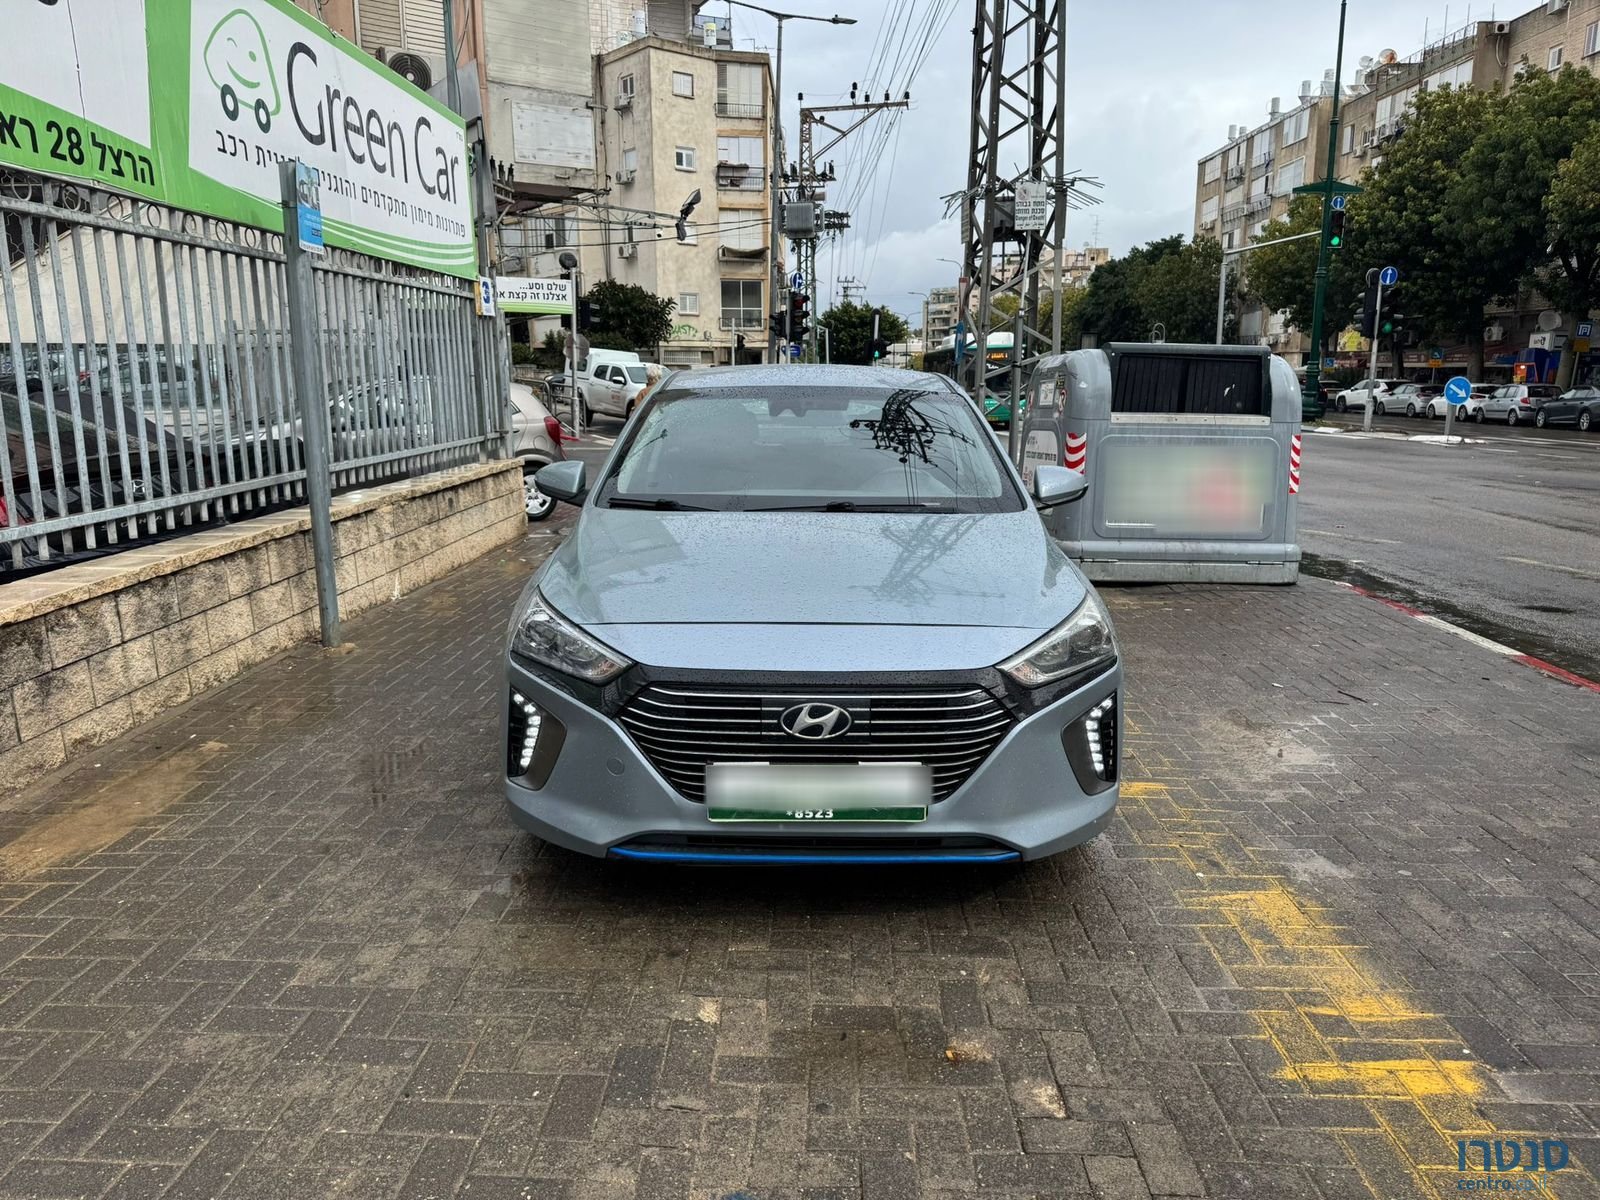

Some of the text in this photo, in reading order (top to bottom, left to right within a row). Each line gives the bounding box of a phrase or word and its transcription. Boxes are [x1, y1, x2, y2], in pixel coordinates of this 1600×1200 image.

[287, 42, 459, 204] Green Car
[46, 120, 85, 166] 28
[215, 129, 249, 162] רכב
[90, 131, 155, 186] הרצל
[361, 185, 408, 217] מתקדמים
[410, 204, 434, 225] מימון
[435, 214, 466, 238] פתרונות
[508, 291, 528, 302] קצת
[530, 292, 541, 300] זה
[543, 292, 567, 301] אצלנו
[547, 281, 567, 291] שלם
